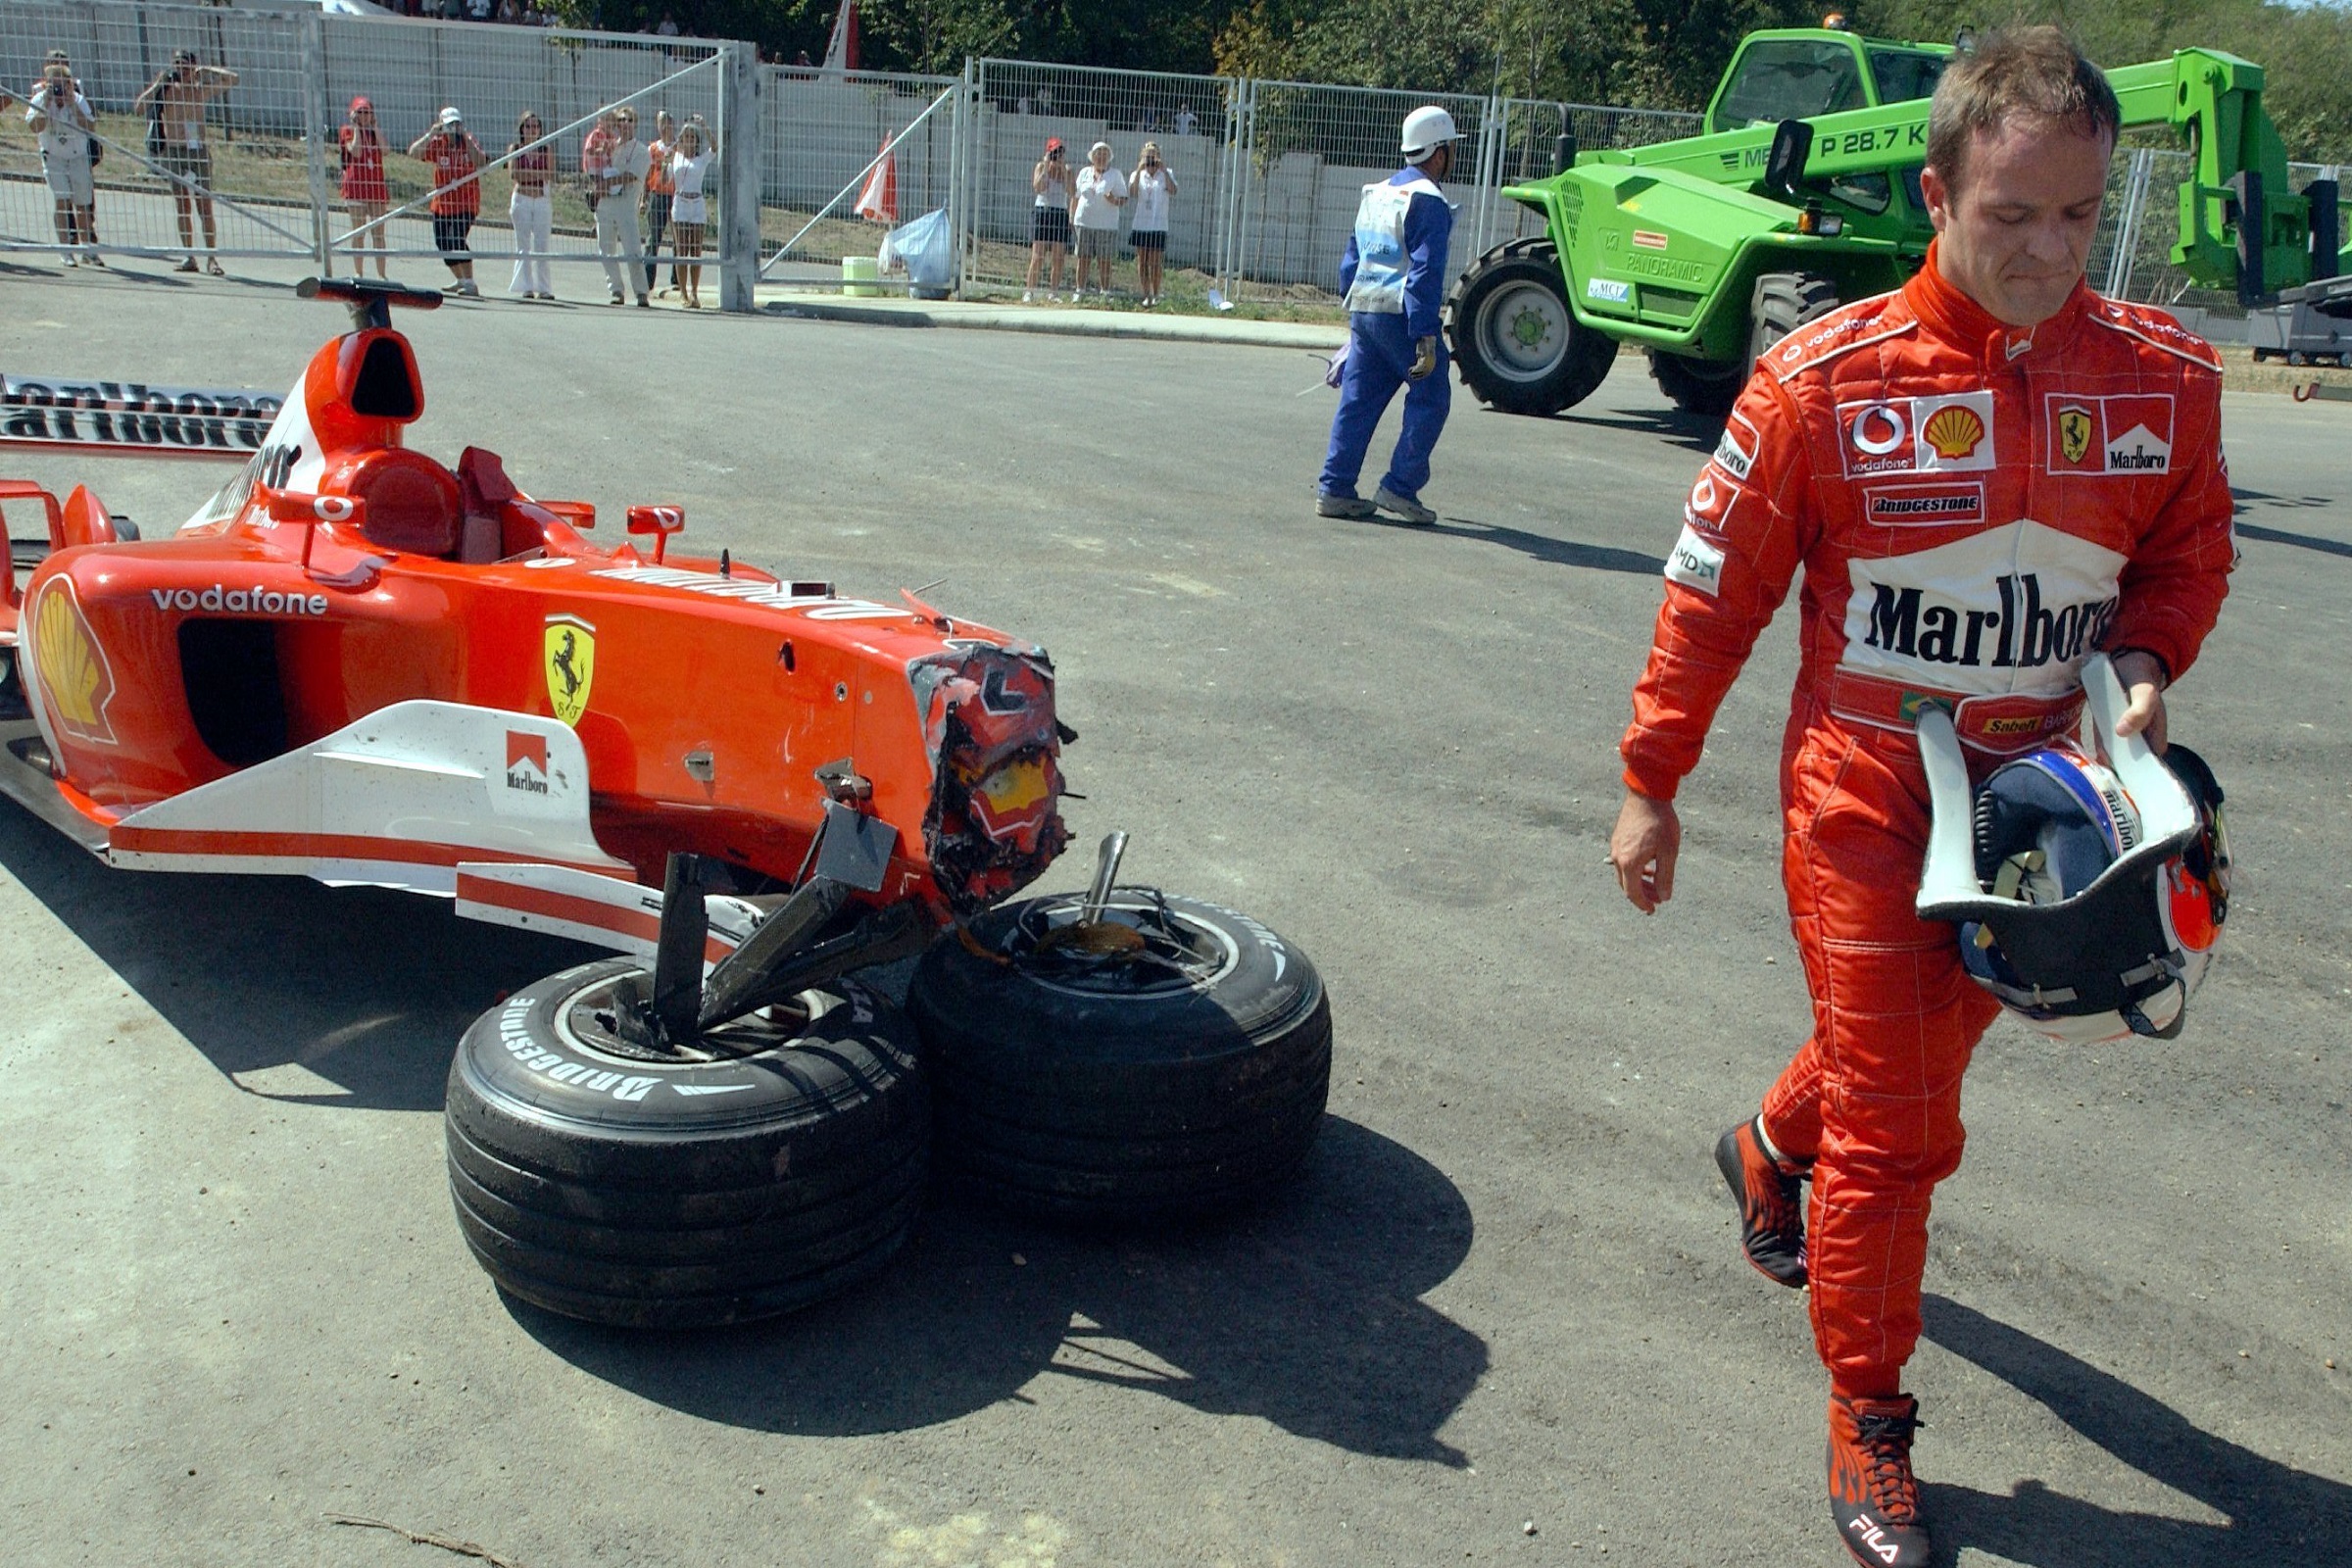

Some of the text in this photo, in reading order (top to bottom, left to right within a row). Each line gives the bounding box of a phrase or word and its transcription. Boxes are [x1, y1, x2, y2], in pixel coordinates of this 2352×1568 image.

[1821, 137, 1836, 157] P
[1843, 128, 1899, 154] 28.7
[1627, 253, 1703, 282] PANORAMIC
[1806, 317, 1878, 347] vodafone
[0, 373, 284, 448] arlboro
[1851, 458, 1909, 472] vodafone
[2110, 445, 2166, 468] Marlboro
[1873, 497, 1979, 513] BRIDGESTONE
[152, 584, 327, 614] vodafone
[1864, 573, 2117, 667] Marlboro
[507, 771, 548, 795] Marlboro
[499, 997, 664, 1102] BRIDGESTONE
[1849, 1514, 1899, 1564] FILA
